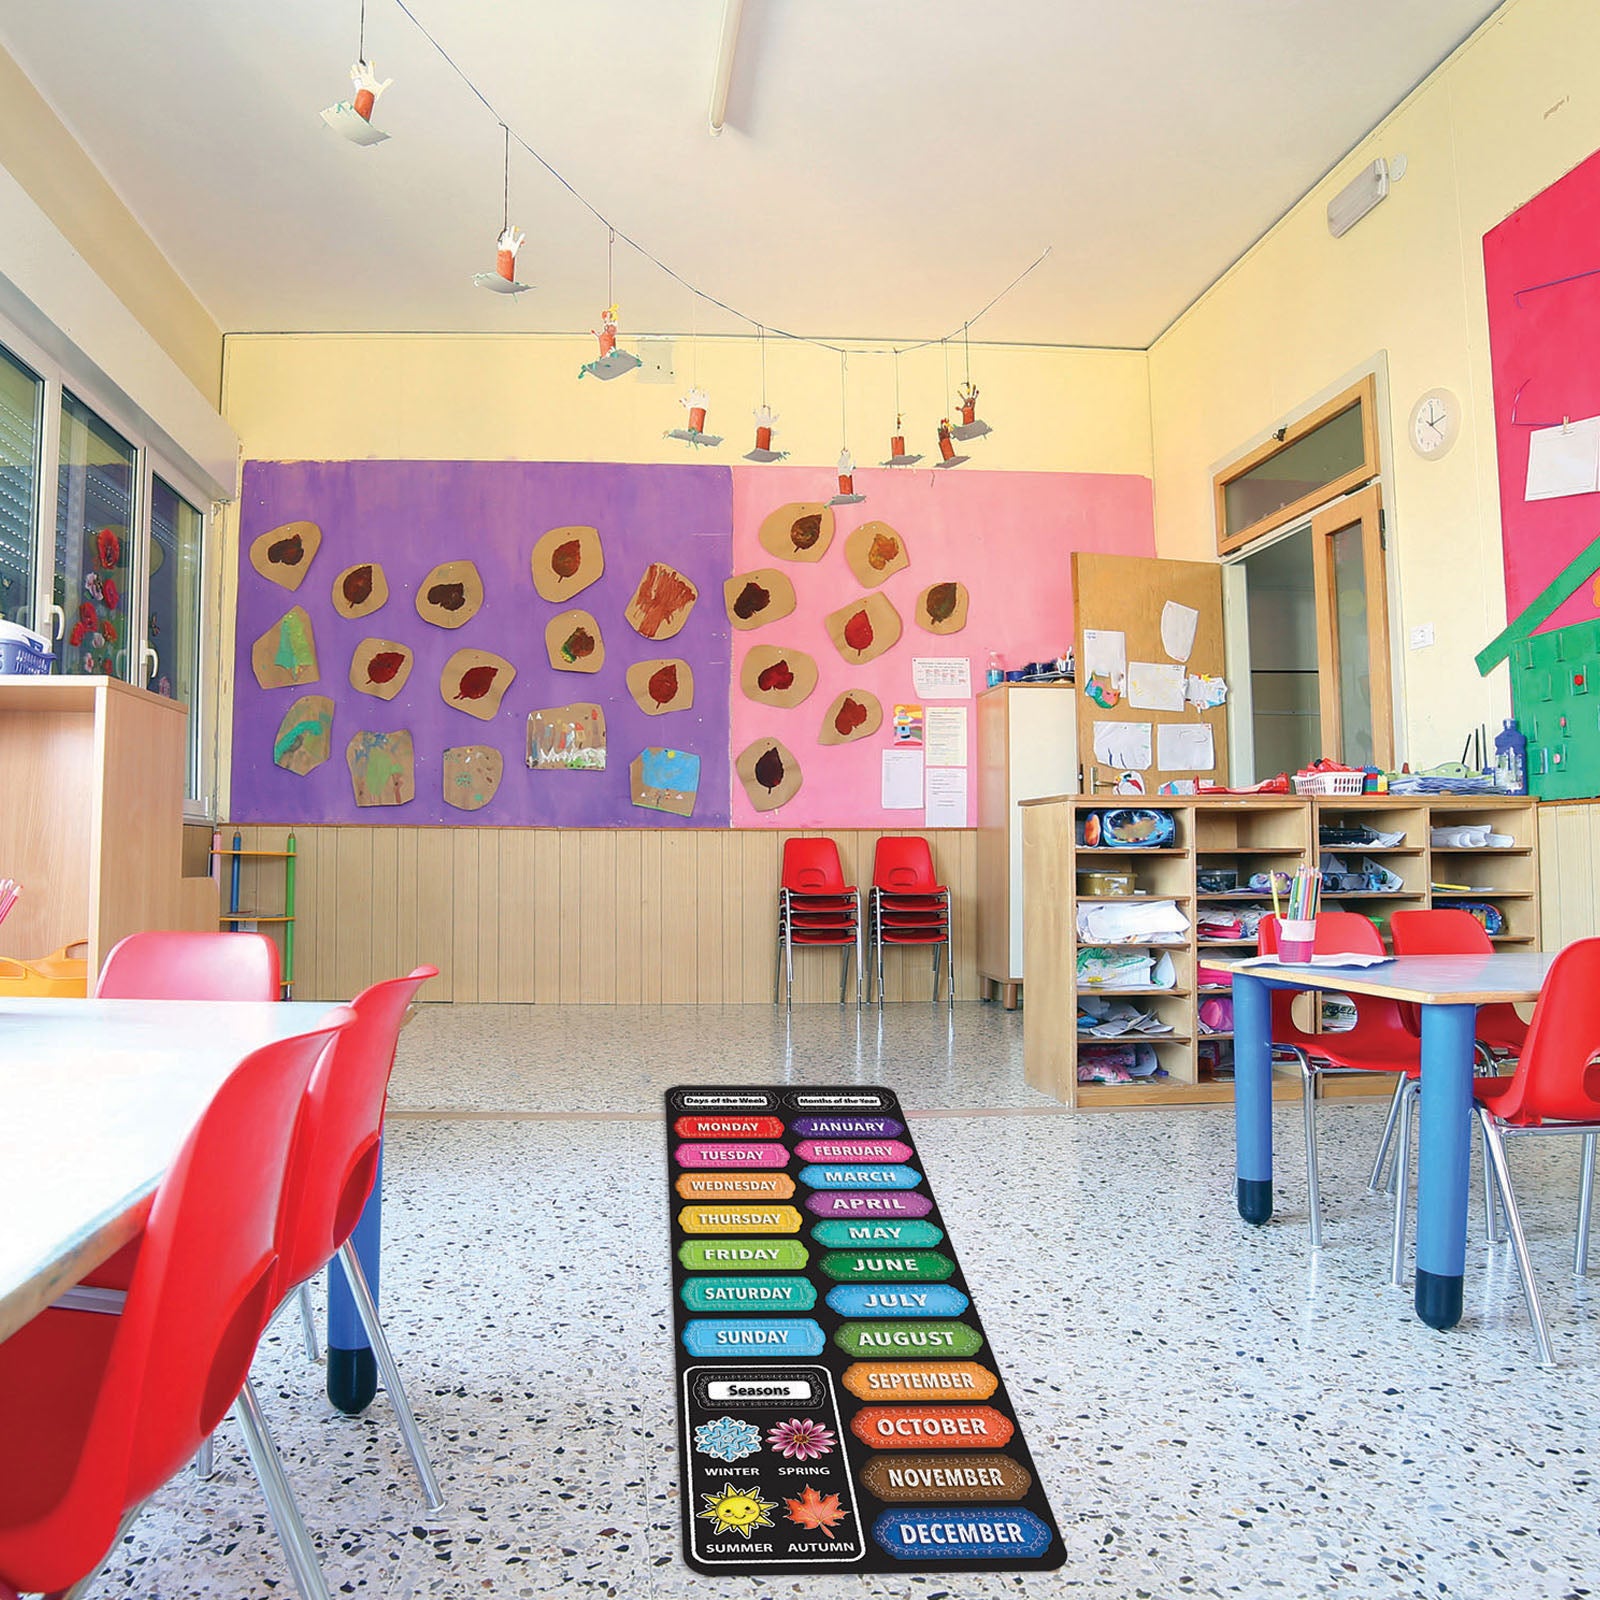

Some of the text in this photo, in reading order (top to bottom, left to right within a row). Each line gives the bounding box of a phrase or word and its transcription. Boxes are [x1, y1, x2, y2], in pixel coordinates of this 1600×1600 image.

[697, 1122, 759, 1132] MONDAY
[810, 1121, 885, 1132] JANUARY
[700, 1150, 764, 1161] TUESDAY
[814, 1146, 893, 1156] FEBRUARY
[825, 1171, 896, 1182] MARCH
[691, 1180, 777, 1191] WEDNESDAY
[832, 1198, 906, 1210] APRIL
[699, 1213, 781, 1225] THURSDAY
[849, 1227, 902, 1239] MAY
[704, 1248, 780, 1260] FRIDAY
[852, 1259, 919, 1272] JUNE
[705, 1287, 793, 1300] SATURDAY
[864, 1293, 928, 1307] JULY
[716, 1330, 789, 1345] SUNDAY
[858, 1331, 954, 1347] AUGUST
[868, 1372, 975, 1389] SEPTEMBER
[728, 1384, 791, 1397] Seasons
[876, 1417, 989, 1437] OCTOBER
[704, 1466, 760, 1476] WINTER
[778, 1466, 831, 1476] SPRING
[888, 1467, 1006, 1488] NOVEMBER
[900, 1521, 1026, 1546] DECEMBER
[705, 1542, 774, 1553] SUMMER
[787, 1542, 856, 1553] AUTUMN
